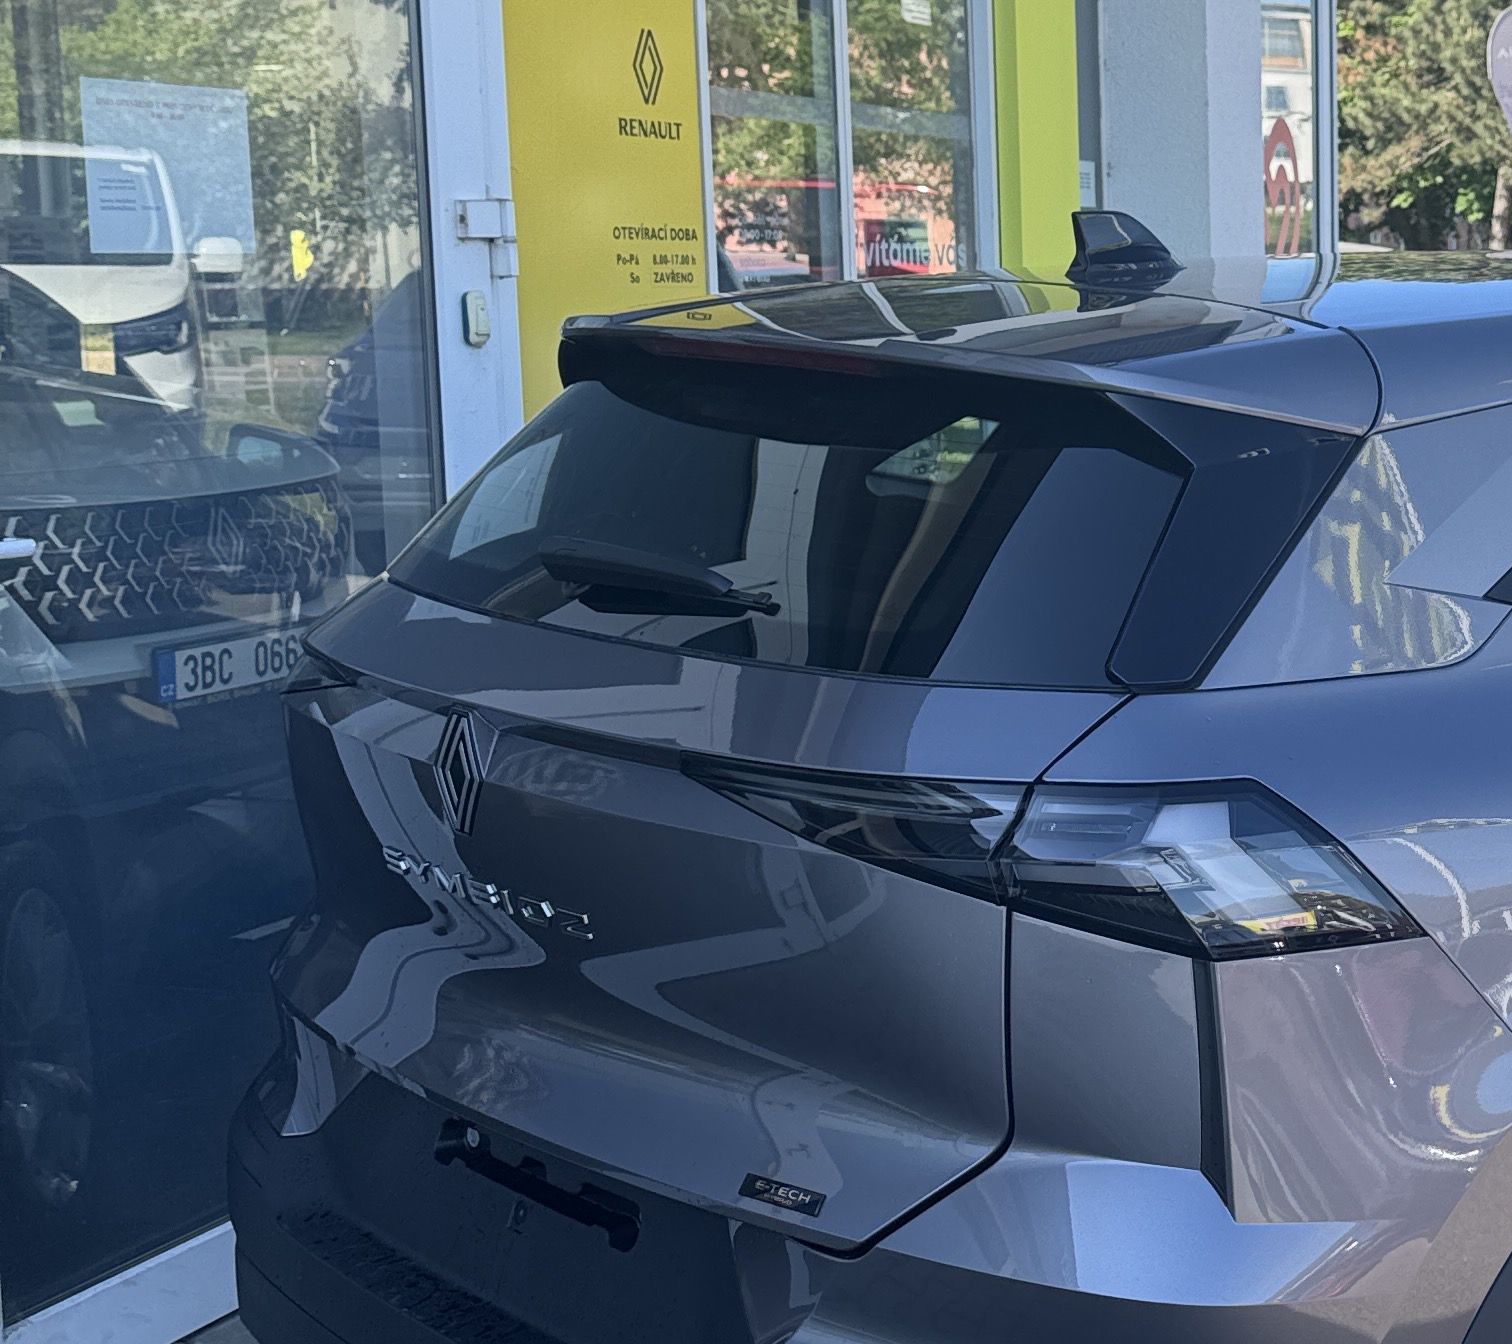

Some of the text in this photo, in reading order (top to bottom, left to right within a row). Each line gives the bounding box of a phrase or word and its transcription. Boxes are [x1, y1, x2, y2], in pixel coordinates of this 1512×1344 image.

[618, 117, 682, 141] RENAULT
[613, 223, 699, 242] OTEVÍRACÍ DOBA
[616, 253, 640, 266] Po-Pá
[630, 269, 695, 284] So ZAVŘENO
[183, 633, 303, 692] 3BC 066
[160, 684, 175, 697] CZ
[755, 1179, 812, 1205] E-TECH
